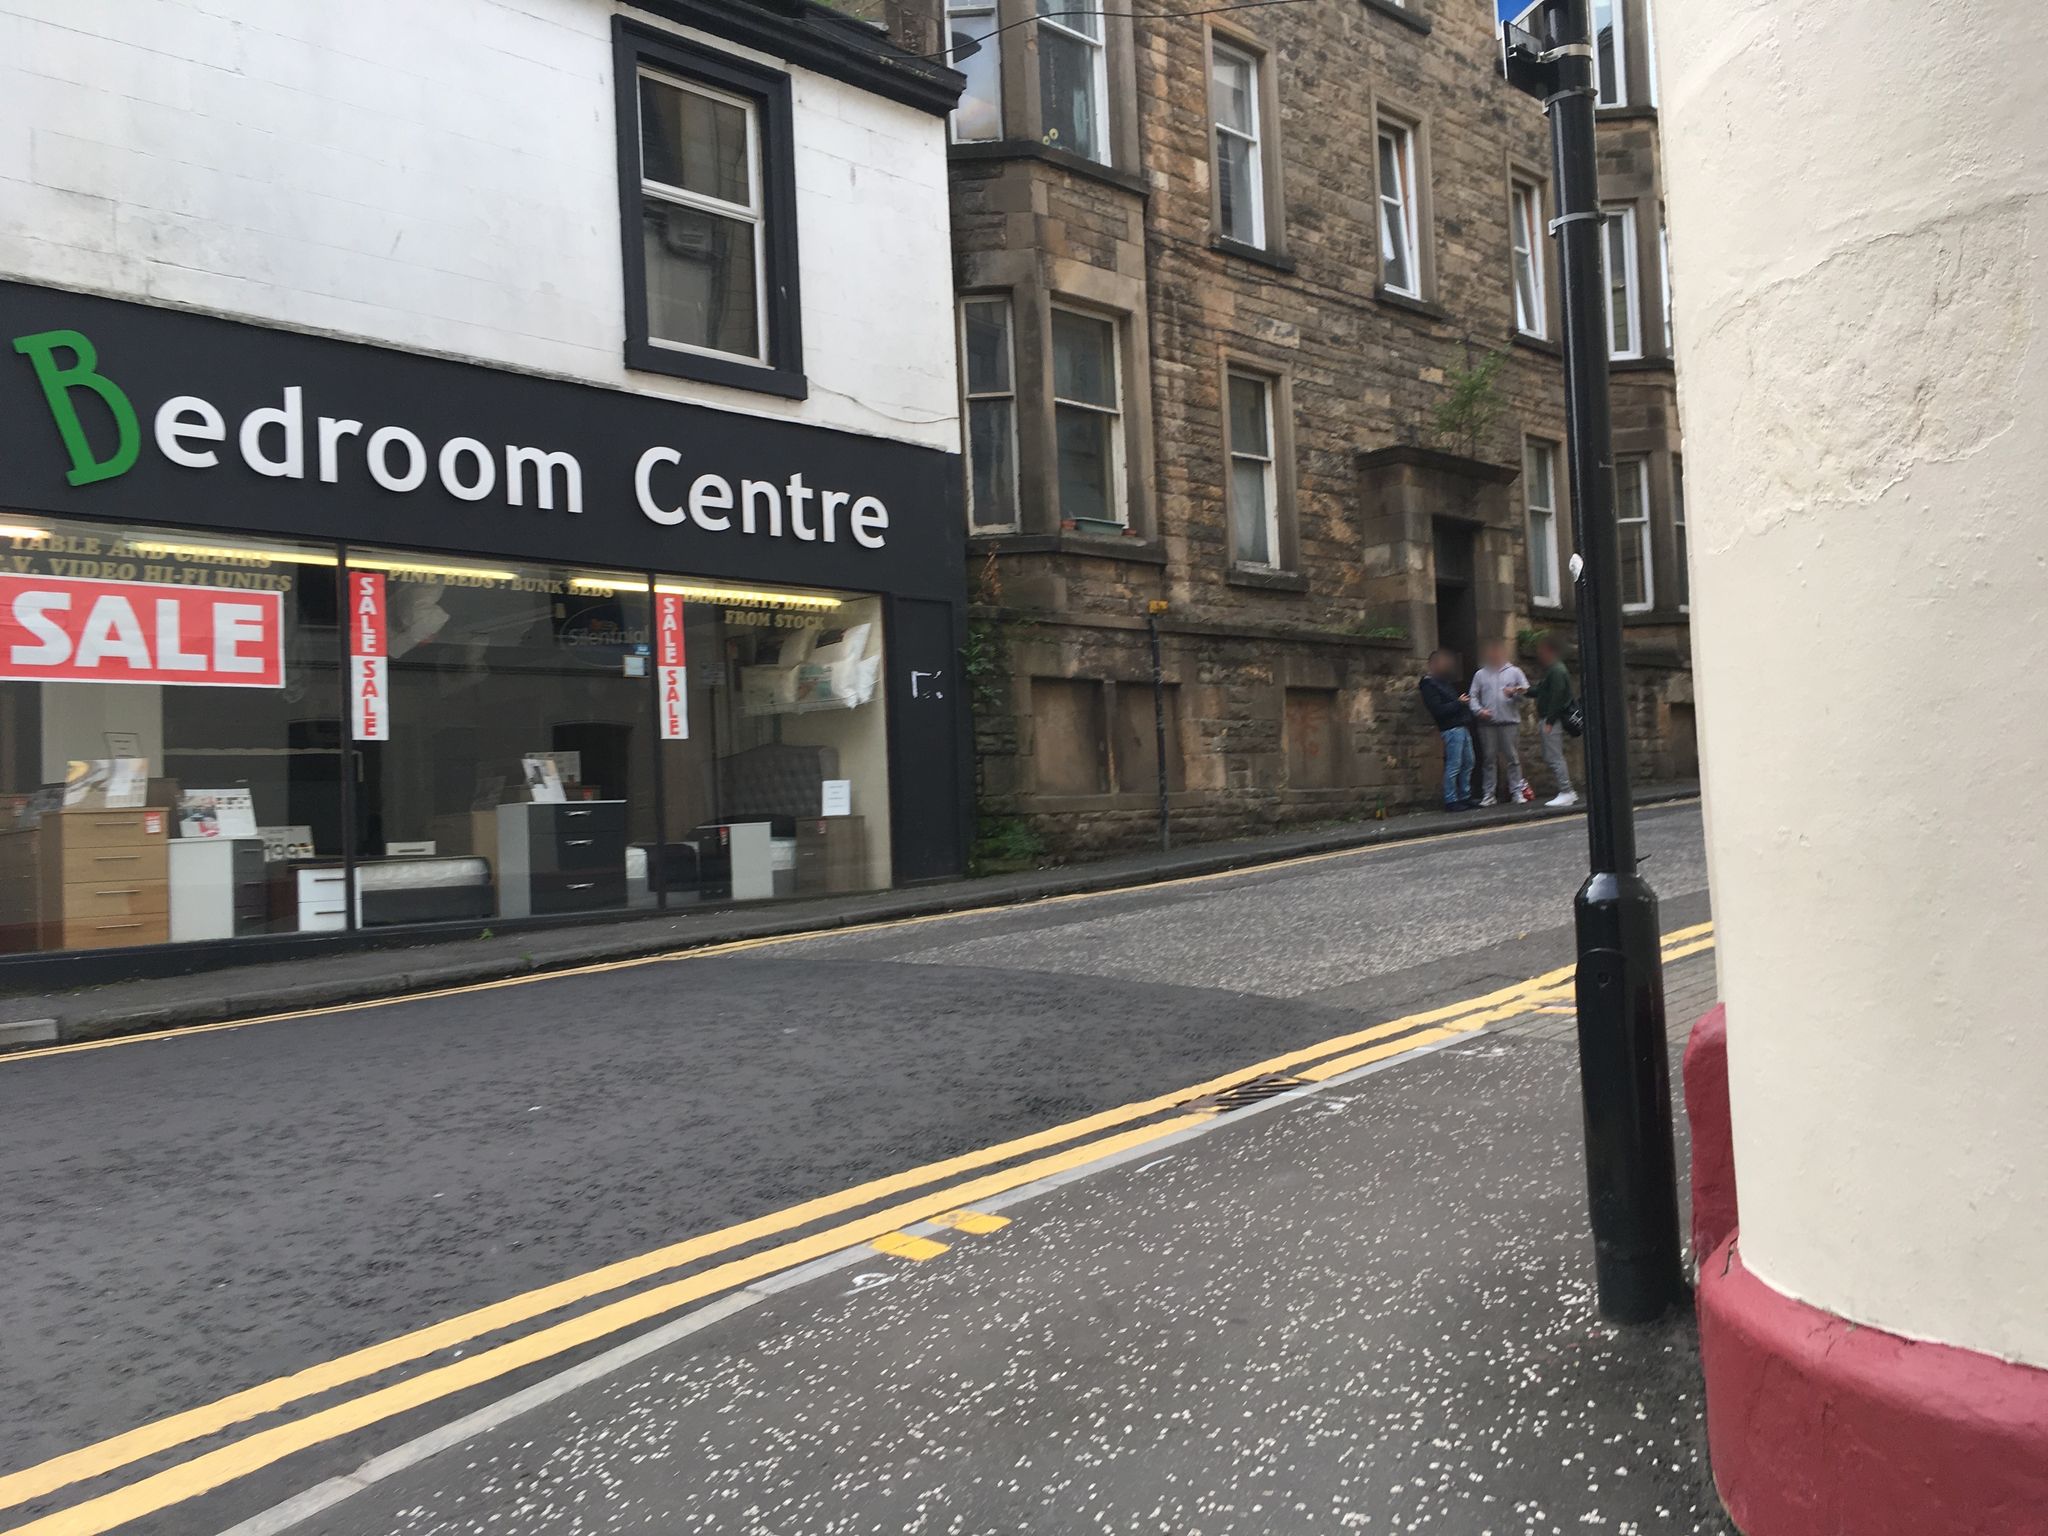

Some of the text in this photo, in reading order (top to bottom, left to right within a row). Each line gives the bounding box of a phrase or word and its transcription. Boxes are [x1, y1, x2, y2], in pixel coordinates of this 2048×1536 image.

[13, 328, 891, 549] Bedroom Centre
[9, 535, 101, 556] TABLE
[109, 540, 169, 561] AND
[50, 557, 137, 581] VIDEO
[144, 565, 209, 587] HI-FI
[215, 571, 293, 592] UNITS
[358, 577, 377, 653] SALE
[388, 568, 439, 584] PINE
[443, 572, 495, 589] BEDS
[511, 577, 563, 595] BUNK
[569, 582, 614, 599] BEDS
[10, 590, 265, 674] SALE
[662, 597, 677, 663] SALE
[724, 609, 825, 631] FROM STOCK
[360, 659, 378, 736] SALE
[664, 669, 681, 736] SALE
